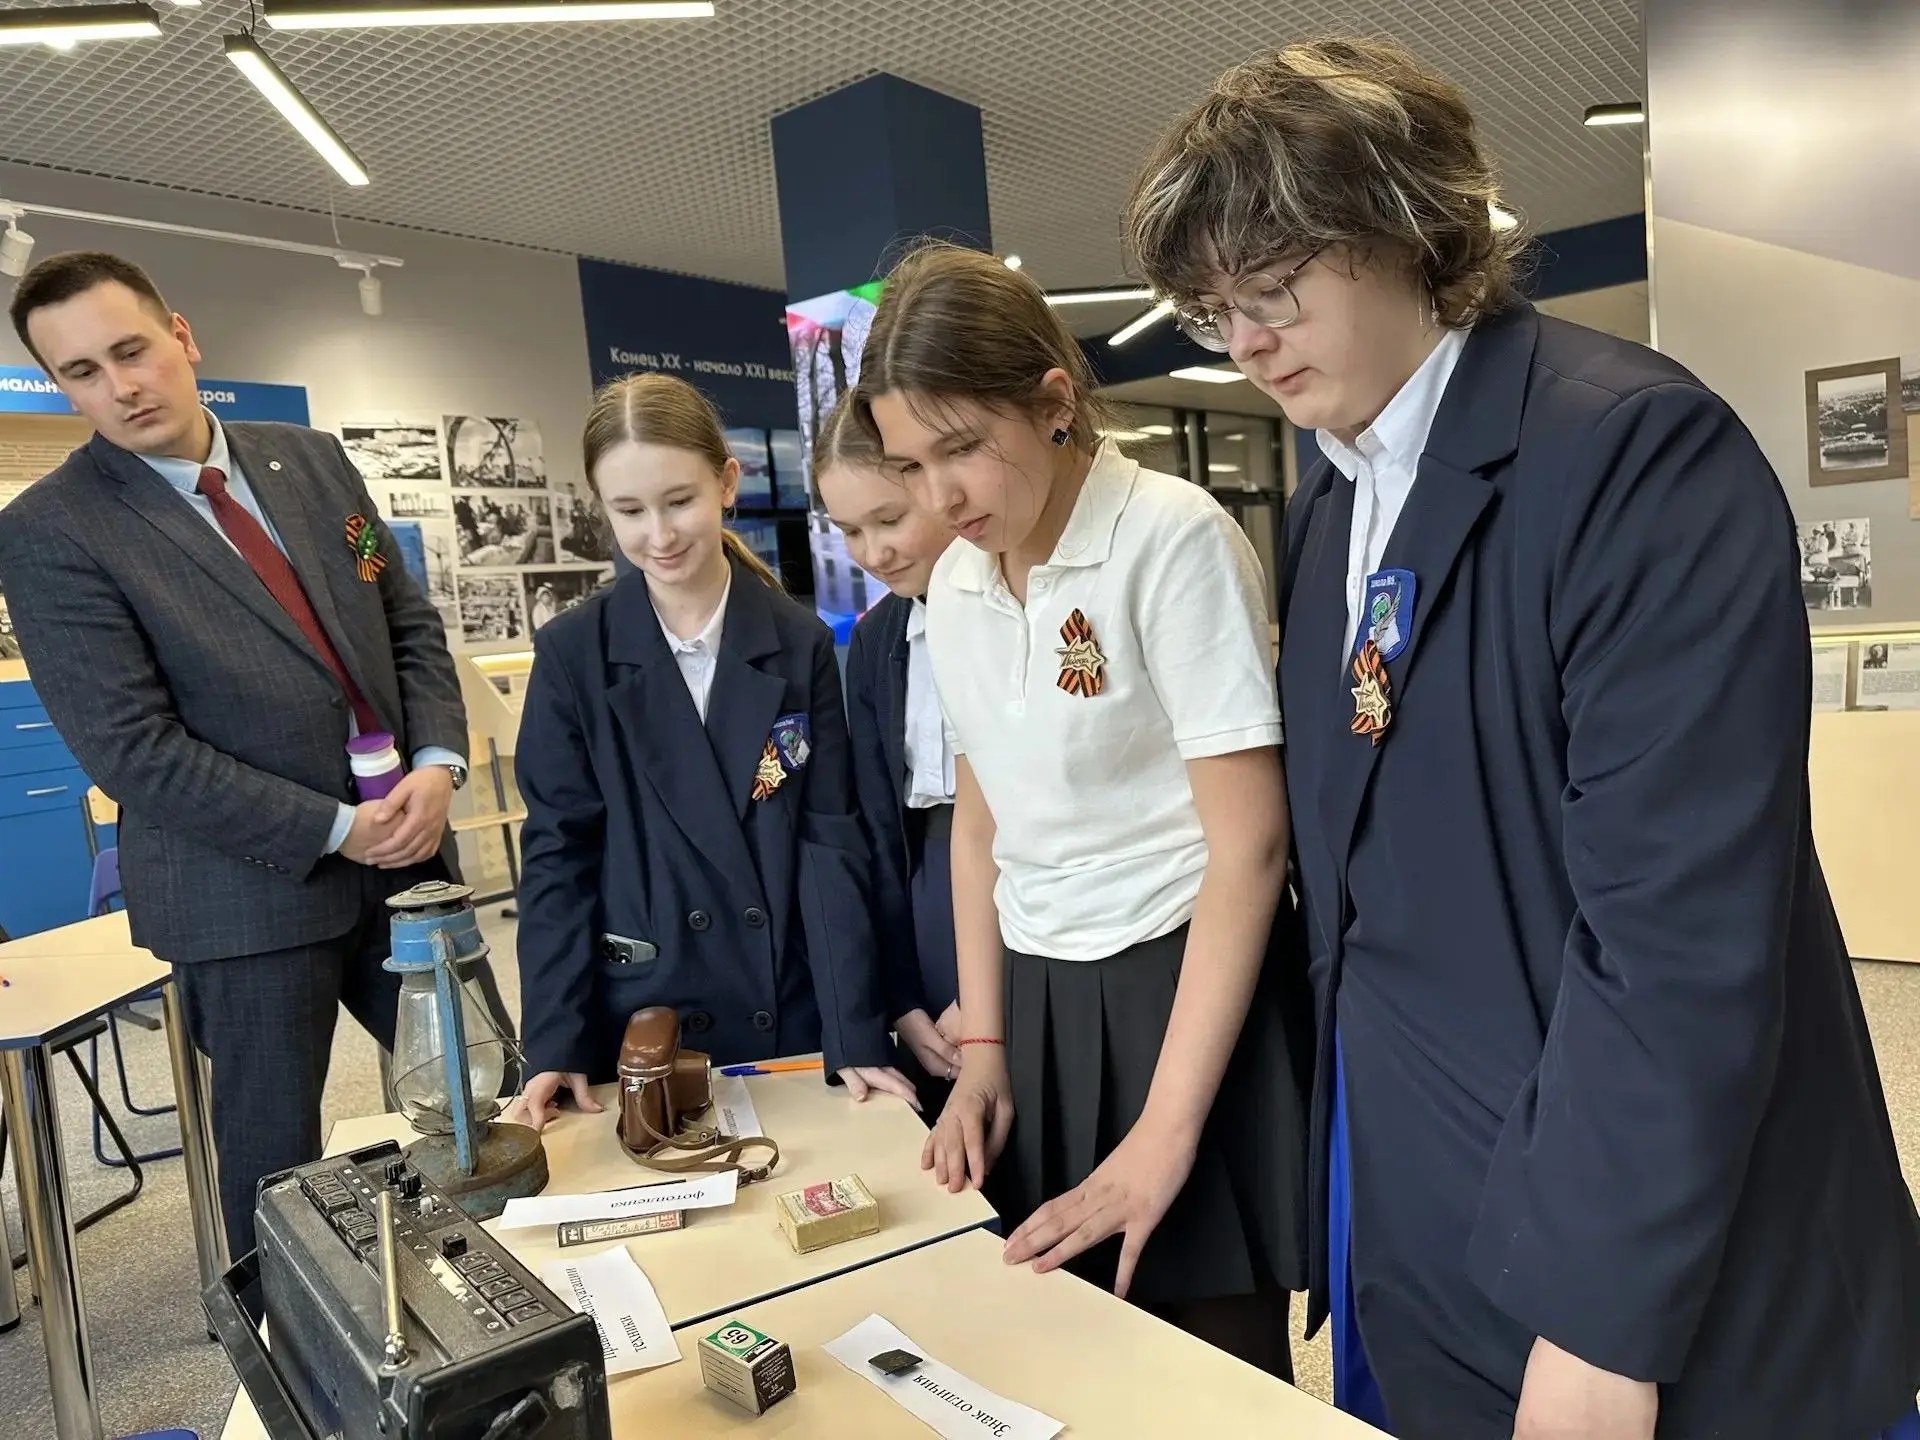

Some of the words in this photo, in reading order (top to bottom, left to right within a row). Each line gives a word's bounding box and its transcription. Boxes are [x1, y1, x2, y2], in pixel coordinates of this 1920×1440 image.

[609, 347, 659, 369] Конец
[693, 359, 743, 376] начало
[0, 377, 62, 394] иальн
[610, 1190, 705, 1208] фотопленка
[565, 1267, 599, 1321] ксплуатации
[619, 1314, 647, 1353] техники
[721, 1328, 749, 1345] 65
[912, 1374, 973, 1414] отличия
[971, 1410, 1011, 1438] Знак
